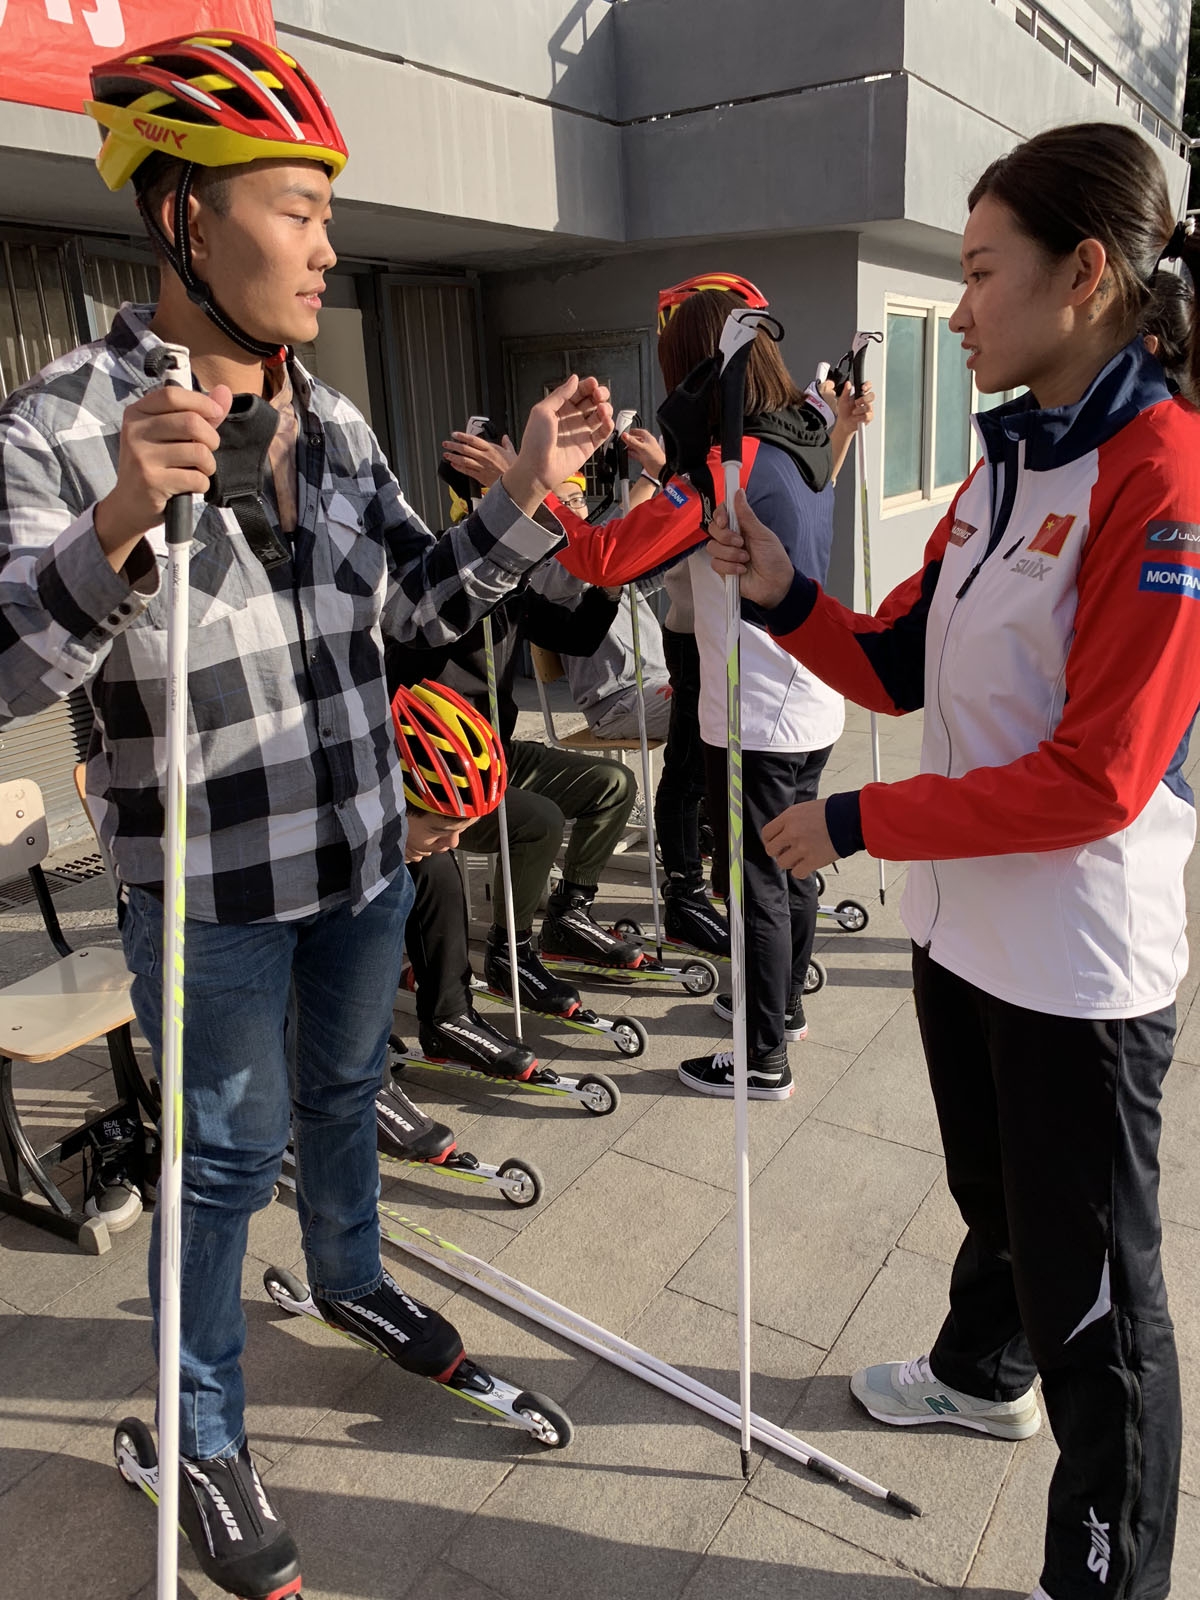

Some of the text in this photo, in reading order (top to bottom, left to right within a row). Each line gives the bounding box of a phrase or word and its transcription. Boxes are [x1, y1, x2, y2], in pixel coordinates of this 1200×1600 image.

[103, 1120, 120, 1129] REAL
[104, 1128, 121, 1137] STAR
[339, 1300, 410, 1343] ADSHUS
[922, 1393, 960, 1416] N
[184, 1463, 243, 1541] ADSHUS
